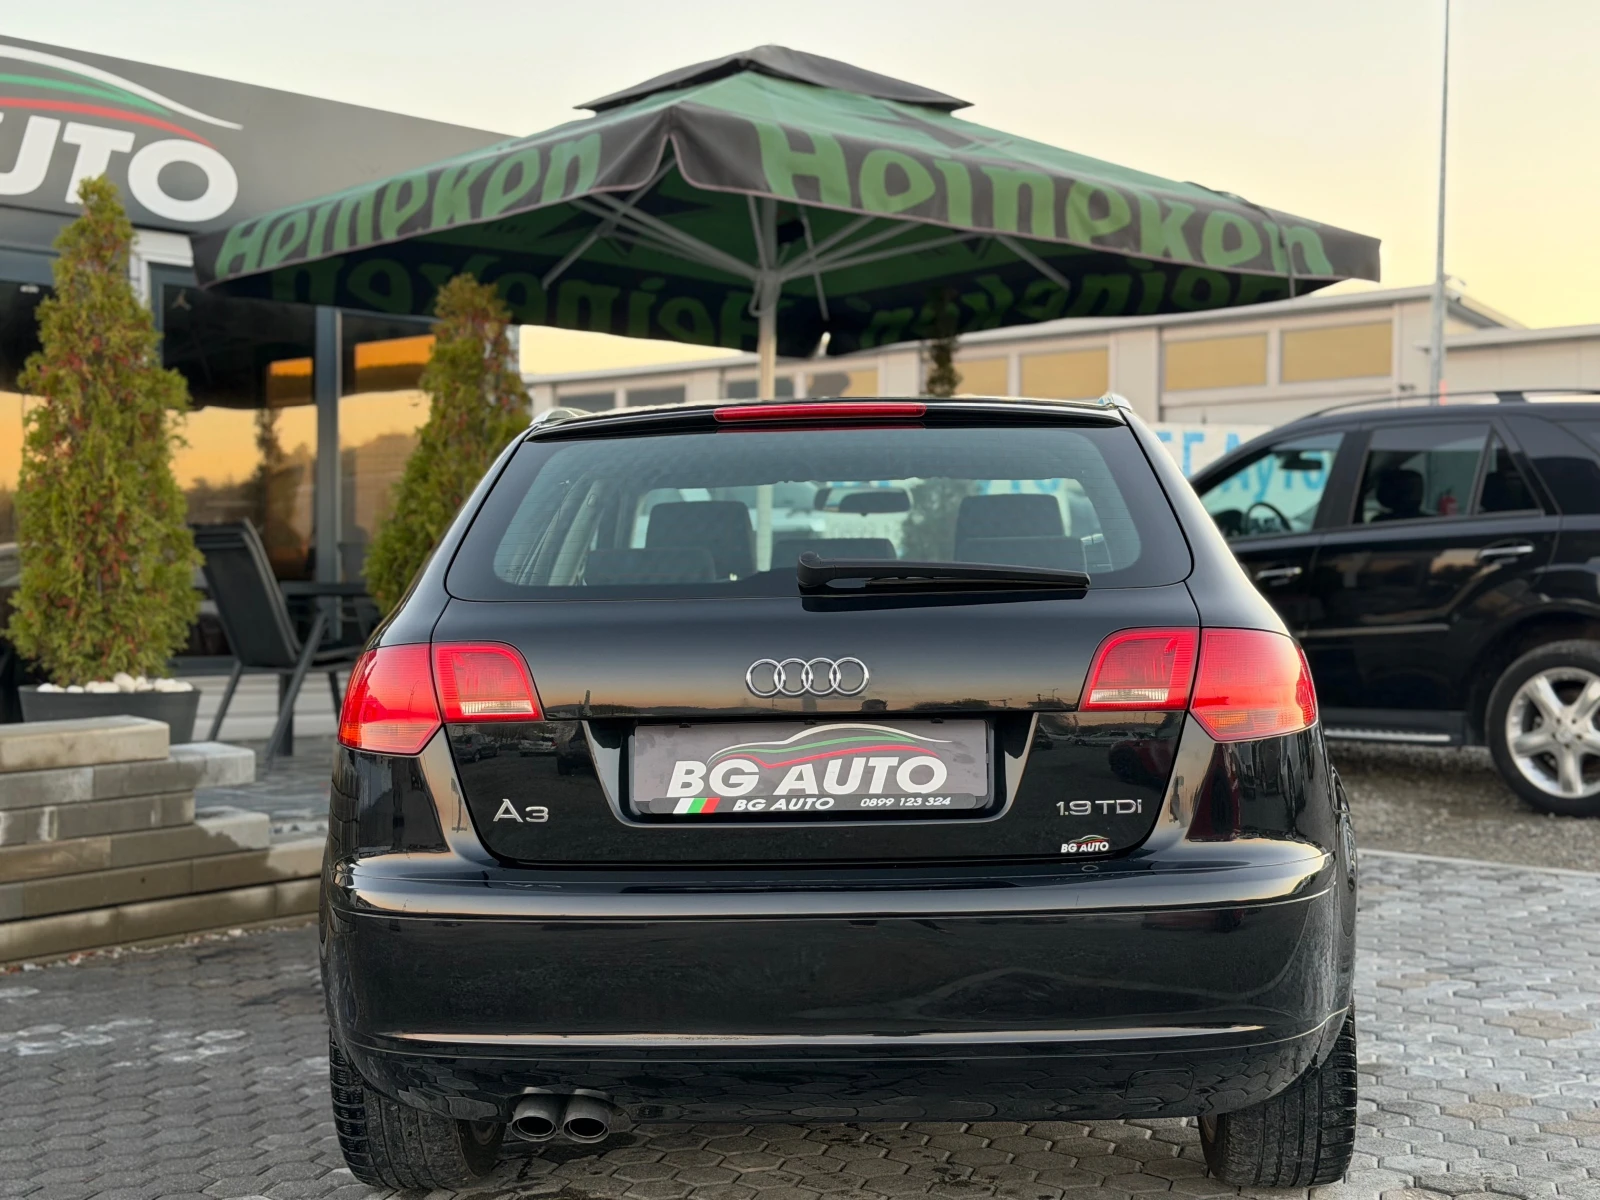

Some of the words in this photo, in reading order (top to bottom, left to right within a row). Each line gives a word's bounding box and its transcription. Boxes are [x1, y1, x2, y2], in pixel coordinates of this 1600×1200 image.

[666, 759, 760, 798] BG
[773, 756, 948, 796] AUTO
[493, 798, 549, 823] A3
[732, 798, 766, 811] BG
[769, 797, 835, 811] AUTO
[860, 798, 895, 808] 0899
[899, 797, 922, 807] 123
[925, 796, 952, 806] 324
[1056, 800, 1092, 816] 1.9
[1060, 843, 1077, 853] BG
[1079, 842, 1109, 852] AUTO
